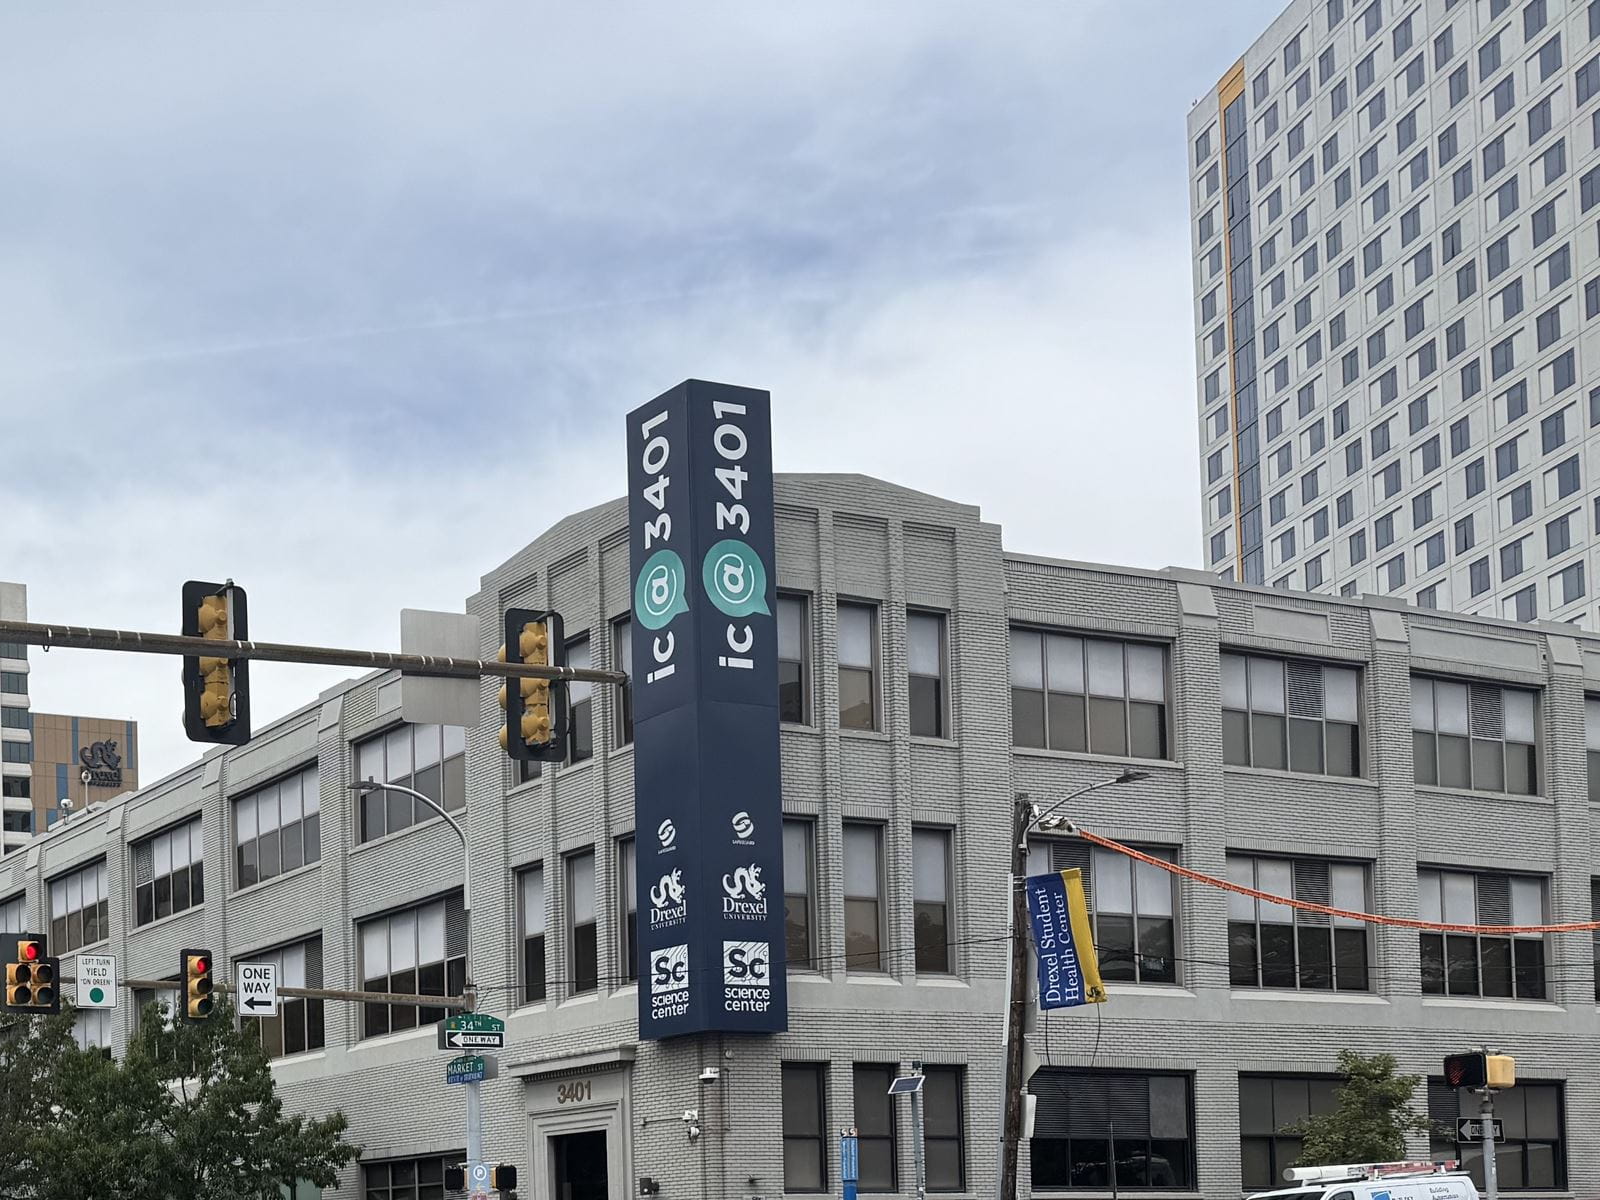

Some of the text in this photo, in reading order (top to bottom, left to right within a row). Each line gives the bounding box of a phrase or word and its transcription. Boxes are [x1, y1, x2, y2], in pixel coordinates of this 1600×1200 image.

[81, 766, 121, 782] rexel
[650, 899, 687, 924] Drexel
[722, 897, 768, 914] Drexel
[650, 917, 687, 931] UNIVERSITY
[1035, 887, 1062, 1003] Drexel Student
[1053, 892, 1080, 1002] Health Center
[96, 958, 111, 966] TURN
[728, 949, 766, 979] Sc
[86, 967, 107, 977] YIELD
[242, 967, 271, 980] ONE
[655, 956, 686, 986] Sc
[243, 982, 272, 994] WAY
[724, 987, 771, 1000] science
[651, 990, 689, 1008] science
[724, 999, 771, 1012] center
[651, 1003, 689, 1020] center
[460, 1020, 501, 1031] 34TH ST
[463, 1036, 497, 1044] ONE WAY
[447, 1061, 473, 1076] MARKET
[557, 1080, 592, 1104] 3401
